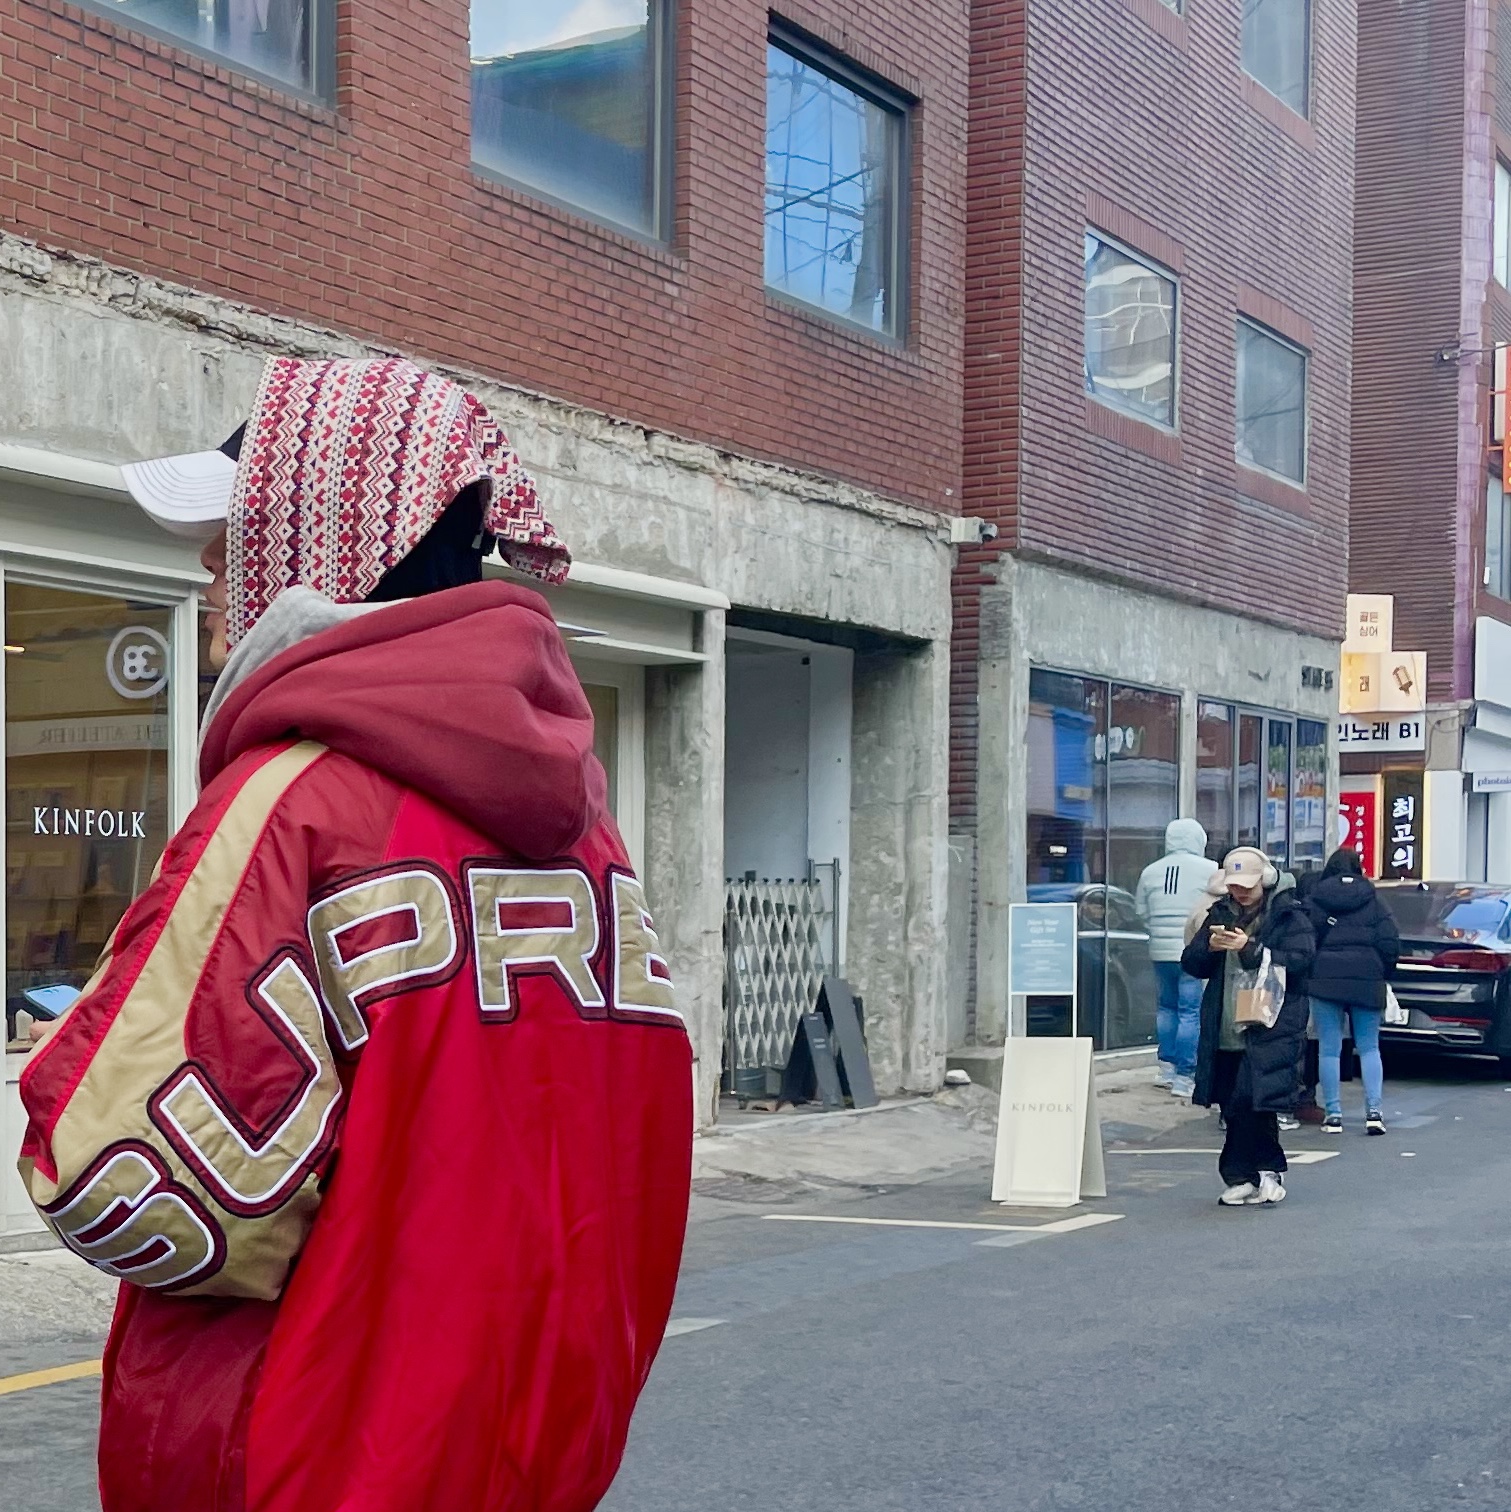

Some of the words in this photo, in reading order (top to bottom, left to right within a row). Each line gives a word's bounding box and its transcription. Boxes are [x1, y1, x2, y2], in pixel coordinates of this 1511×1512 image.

[1399, 722, 1419, 739] B1
[33, 806, 146, 838] KINFOLK
[1391, 795, 1415, 870] 최고의
[1011, 1103, 1073, 1113] KINFOLK
